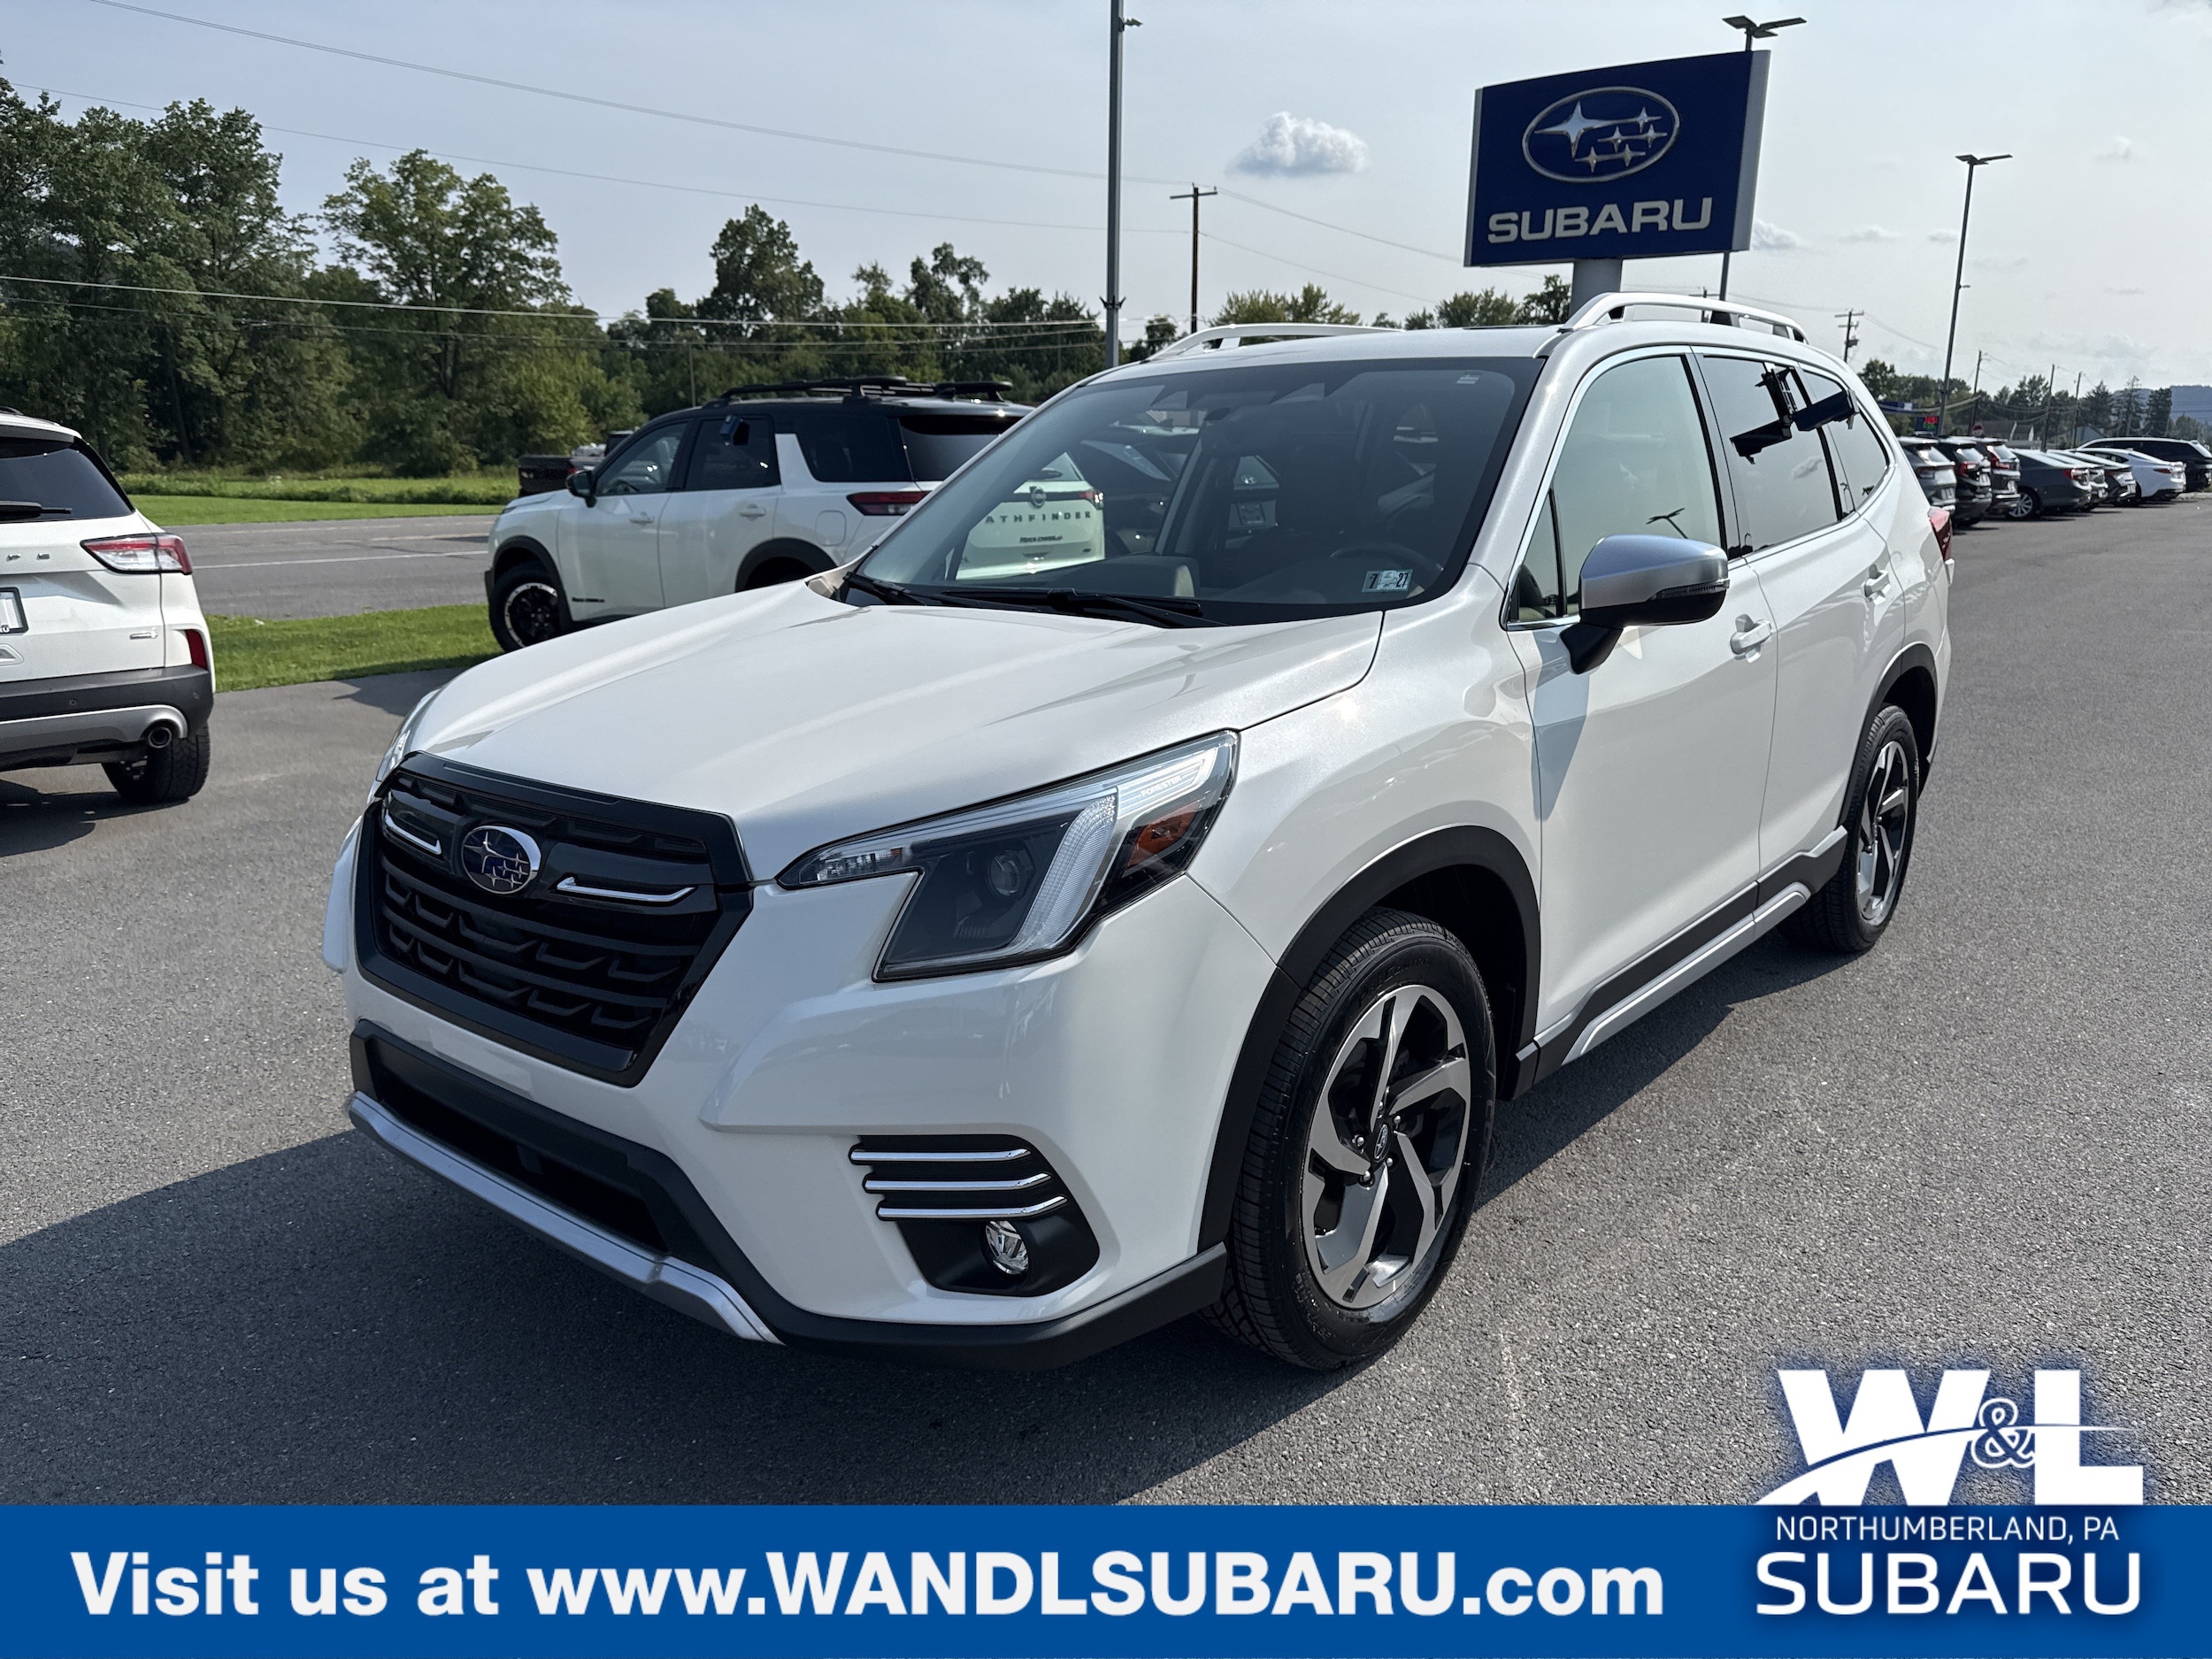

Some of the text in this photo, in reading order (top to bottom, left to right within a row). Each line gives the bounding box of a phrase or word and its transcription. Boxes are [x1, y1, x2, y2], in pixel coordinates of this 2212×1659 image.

[1487, 197, 1713, 244] SUBARU
[1369, 572, 1409, 589] 7 27
[1141, 775, 1182, 796] FORESTER
